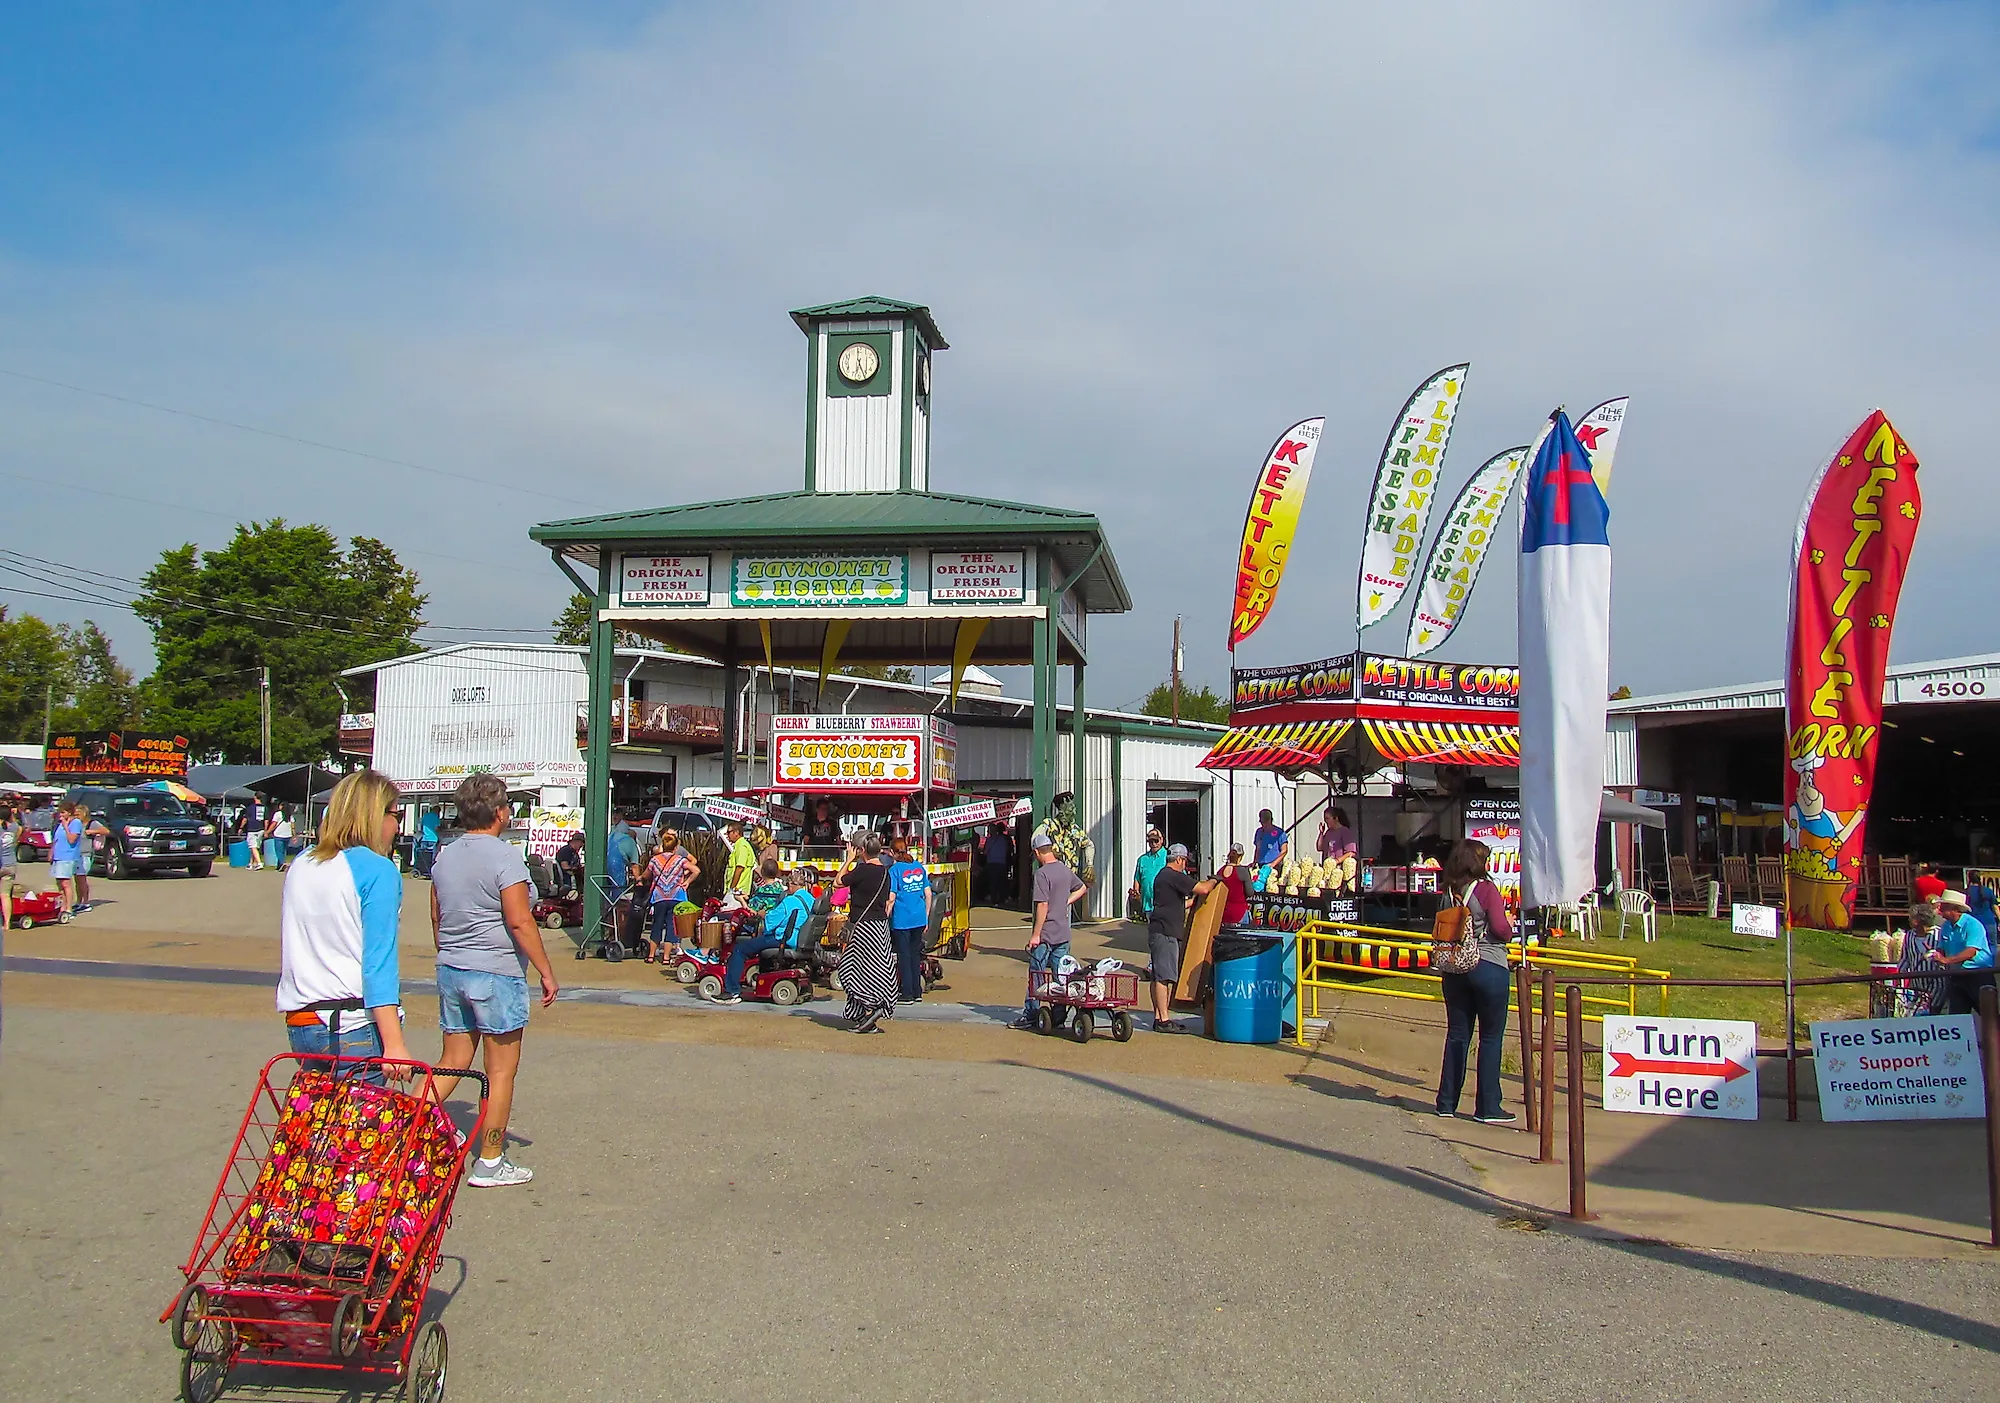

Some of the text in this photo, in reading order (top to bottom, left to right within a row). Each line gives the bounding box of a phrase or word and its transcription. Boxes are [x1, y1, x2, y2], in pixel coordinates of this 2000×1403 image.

[1299, 430, 1319, 440] BEST
[1302, 424, 1320, 433] THE
[1373, 426, 1418, 535] FRESH
[1389, 400, 1449, 577] LEMONADE
[1236, 439, 1308, 599] KETTLE
[1431, 495, 1481, 582] FRESH
[1441, 477, 1507, 620] LEMONADE
[650, 558, 681, 567] THE
[961, 554, 994, 563] THE
[627, 569, 704, 578] ORIGINAL
[748, 560, 891, 578] LEMONADE
[937, 565, 1018, 574] ORIGINAL
[643, 582, 687, 590] FRESH
[773, 580, 864, 596] FRESH
[953, 578, 1001, 587] FRESH
[1234, 540, 1287, 635] CORN
[1365, 573, 1405, 588] Store
[627, 592, 703, 601] LEMONADE
[937, 589, 1017, 598] LEMONADE
[1418, 613, 1453, 630] Store
[1242, 656, 1347, 677] THE ORIGINAL THE BEST
[1363, 657, 1456, 691] KETTLE
[1235, 667, 1353, 705] KETTLE CORN
[1920, 682, 1985, 697] 4500
[467, 686, 485, 702] LOFTS
[1386, 690, 1510, 707] THE ORIGINAL THE BEST
[775, 717, 810, 729] CHERRY
[815, 717, 867, 730] BLUEBERRY
[871, 717, 921, 729] STRAWBERRY
[789, 743, 907, 758] LEMONADE
[517, 762, 535, 771] CONES
[547, 762, 577, 772] CORNEY
[578, 763, 587, 772] DO
[810, 762, 885, 776] FRESH
[416, 781, 436, 790] DOGS
[441, 781, 451, 789] HOT
[551, 777, 581, 785] FUNNEL
[707, 798, 741, 812] BLUEBERRY
[930, 807, 966, 819] BLUEBERRY
[967, 802, 992, 812] CHERRY
[1011, 806, 1030, 815] STORE
[1470, 800, 1520, 809] OFTEN COP
[538, 809, 576, 826] Fresh
[933, 811, 990, 827] STRAWBERRY
[1466, 811, 1520, 820] NEVER EQUA
[531, 829, 578, 842] SQUEEZE
[1478, 828, 1492, 836] THE
[1331, 900, 1353, 911] FREE
[1635, 1025, 1721, 1058] Turn
[1820, 1024, 1961, 1048] Free Samples
[1859, 1054, 1930, 1072] Support
[1830, 1075, 1967, 1092] Freedom Challenge
[1638, 1079, 1719, 1110] Here
[1865, 1092, 1936, 1106] Ministries
